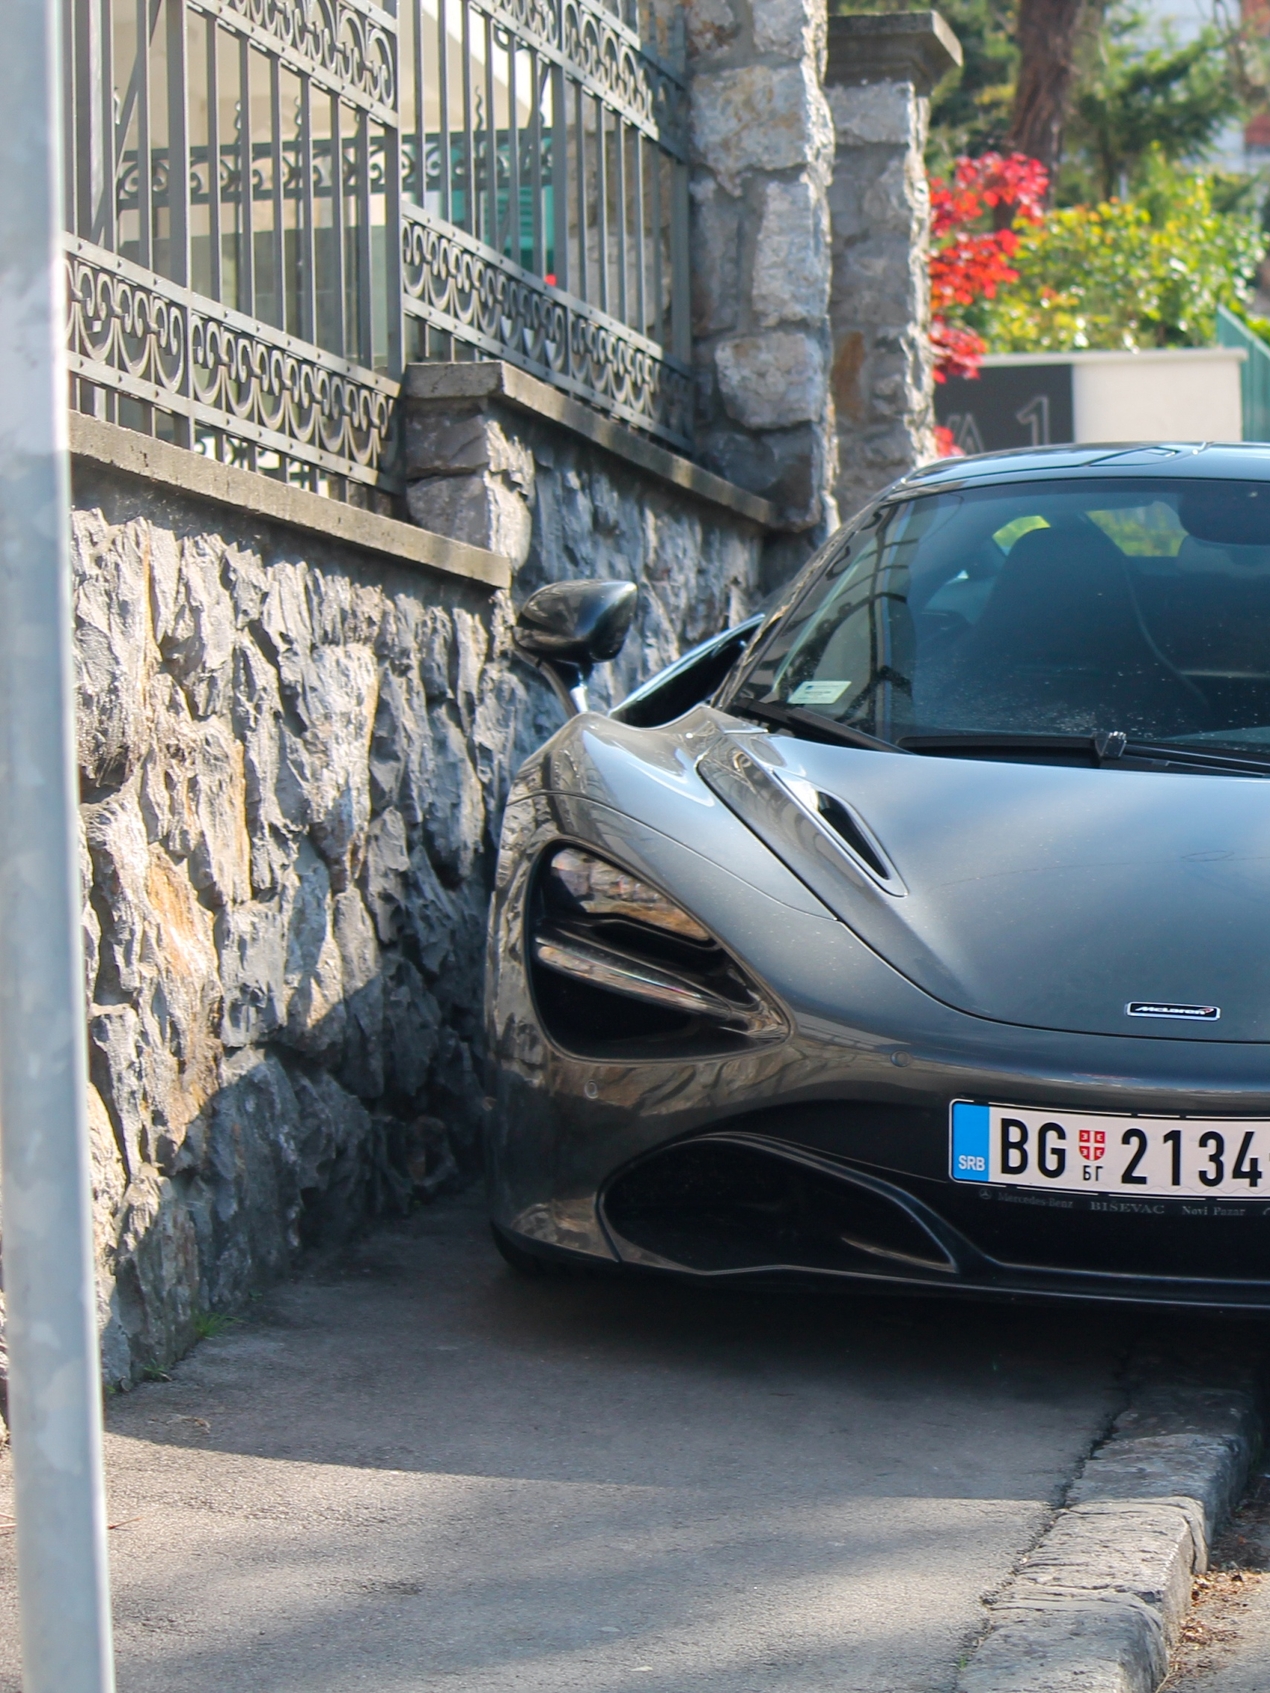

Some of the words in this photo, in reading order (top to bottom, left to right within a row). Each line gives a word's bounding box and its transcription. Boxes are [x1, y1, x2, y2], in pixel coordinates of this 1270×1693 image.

[1134, 1006, 1206, 1015] McLaren
[1001, 1117, 1067, 1178] BG
[958, 1155, 986, 1172] SRB
[998, 1192, 1074, 1209] Mercedes-Benz
[1182, 1205, 1208, 1216] Novi
[1213, 1206, 1246, 1217] Pazar
